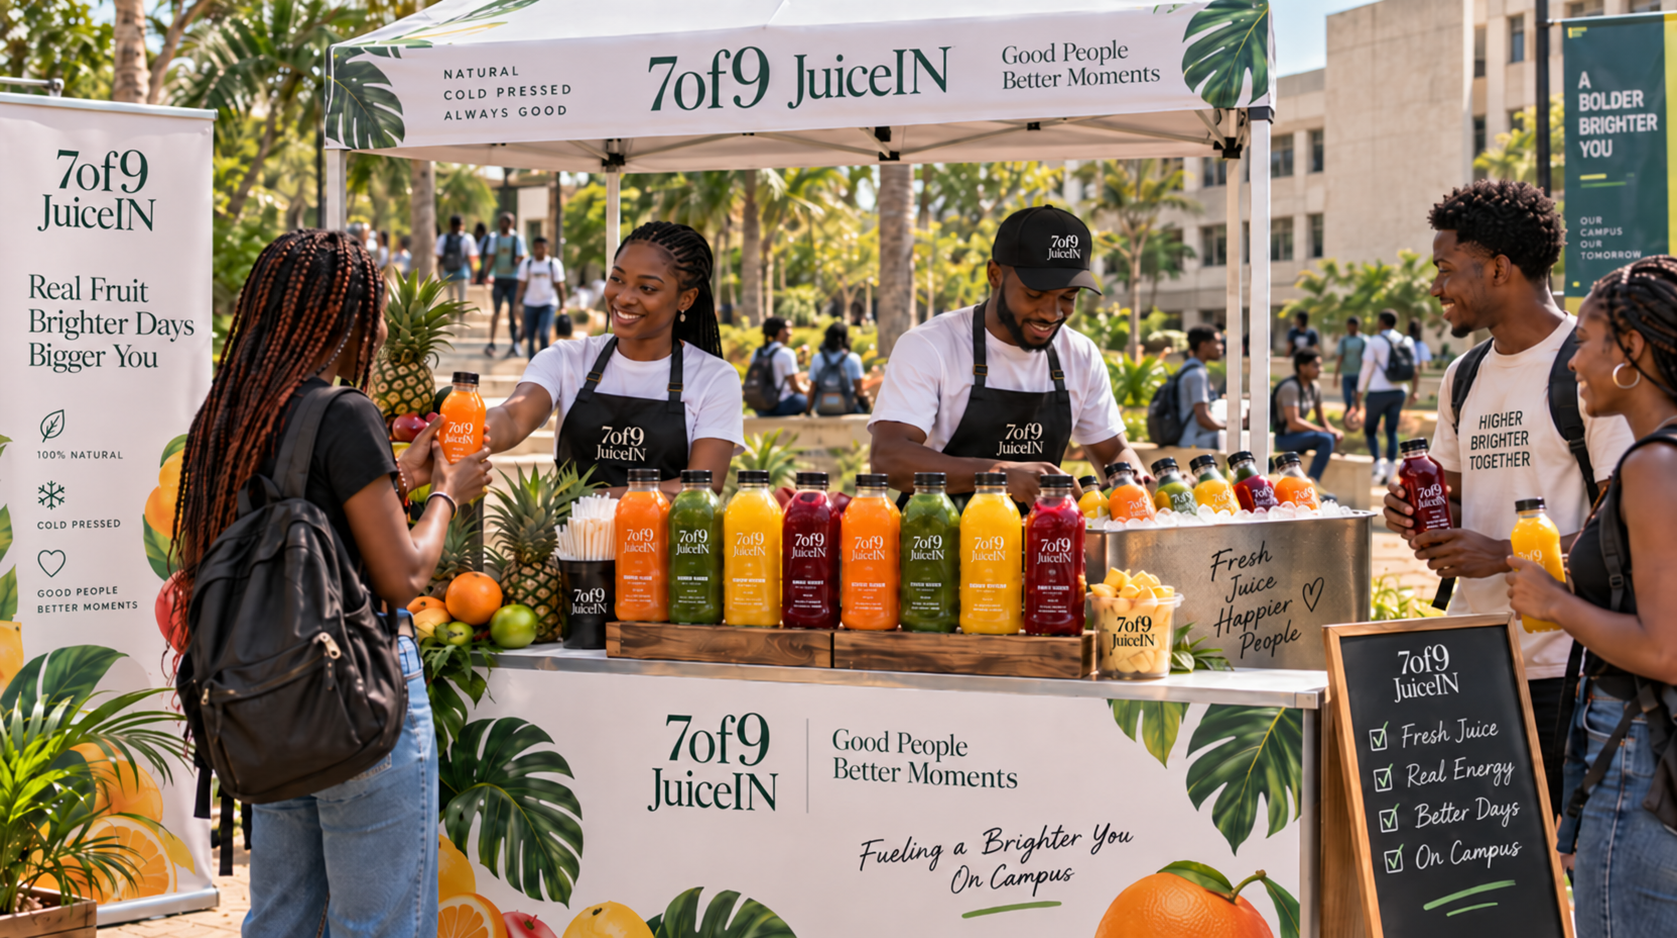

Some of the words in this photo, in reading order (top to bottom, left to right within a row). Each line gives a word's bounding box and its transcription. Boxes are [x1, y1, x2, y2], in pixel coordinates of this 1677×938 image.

[1002, 43, 1056, 65] Good
[1062, 40, 1129, 66] People
[444, 65, 519, 79] NATURAL
[648, 46, 770, 111] 7of9
[787, 46, 952, 110] JuiceIN
[1002, 69, 1062, 90] Better
[1067, 65, 1160, 87] Moments
[1578, 71, 1591, 89] A
[444, 88, 487, 101] COLD
[497, 84, 572, 98] PRESSED
[1579, 90, 1644, 111] BOLDER
[444, 108, 509, 121] ALWAYS
[519, 105, 567, 117] GOOD
[1579, 113, 1658, 135] BRIGHTER
[1580, 139, 1613, 158] YOU
[57, 149, 148, 193] 7of9
[37, 194, 156, 231] JuiceIN
[1580, 216, 1603, 225] OUR
[1051, 234, 1079, 248] 7of9
[1580, 227, 1623, 237] CAMPUS
[1580, 239, 1603, 248] OUR
[1046, 248, 1081, 261] JuiceIN
[1580, 250, 1642, 260] TOMORROW
[28, 274, 81, 300] Real
[90, 277, 149, 302] Fruit
[28, 309, 129, 340] Brighter
[136, 311, 195, 342] Days
[28, 343, 106, 373] Bigger
[113, 344, 159, 368] You
[448, 421, 473, 435] 7of9
[1479, 410, 1523, 430] HIGHER
[601, 425, 645, 447] 7of9
[1005, 422, 1043, 440] 7of9
[1470, 430, 1529, 450] BRIGHTER
[37, 450, 66, 459] 100%
[70, 451, 123, 459] NATURAL
[594, 444, 647, 462] JuiceIN
[996, 441, 1044, 456] JuiceIN
[1469, 451, 1530, 470] TOGETHER
[1417, 483, 1442, 499] 7of9
[37, 521, 67, 530] COLD
[72, 519, 121, 529] PRESSED
[626, 528, 654, 542] 7of9
[679, 529, 708, 543] 7of9
[736, 532, 764, 546] 7of9
[794, 532, 825, 546] 7of9
[854, 535, 884, 550] 7of9
[913, 535, 943, 549] 7of9
[974, 535, 1004, 550] 7of9
[791, 546, 827, 559] JuiceIN
[1040, 537, 1071, 552] 7of9
[1037, 552, 1072, 564] JuiceIN
[1210, 541, 1273, 582] Fresh
[37, 588, 71, 598] GOOD
[76, 586, 118, 596] PEOPLE
[573, 587, 605, 603] 7of9
[1225, 573, 1277, 603] Juice
[37, 604, 78, 613] BETTER
[83, 601, 138, 611] MOMENTS
[571, 602, 608, 616] JuiceIN
[1117, 615, 1152, 634] 7of9
[1213, 599, 1293, 638] Happier
[1112, 633, 1155, 650] JuiceIN
[1239, 619, 1302, 659] People
[1397, 643, 1450, 675] 7of9
[1393, 672, 1459, 703] JuiceIN
[664, 712, 770, 767] 7of9
[1401, 720, 1450, 748] Fresh
[1455, 717, 1499, 743] Juice
[832, 728, 890, 753] Good
[897, 732, 968, 762] People
[832, 757, 901, 783] Better
[907, 761, 1018, 789] Moments
[1406, 759, 1447, 788] Real
[1454, 757, 1515, 787] Energy
[647, 767, 779, 812] JuiceIN
[1414, 802, 1469, 829] Better
[1475, 797, 1520, 827] Days
[859, 836, 943, 871] Fueling
[953, 839, 967, 855] a
[981, 824, 1082, 863] Brighter
[1092, 823, 1134, 855] You
[1416, 844, 1444, 870] On
[1450, 840, 1522, 869] Campus
[950, 864, 983, 894] On
[990, 864, 1075, 897] Campus
